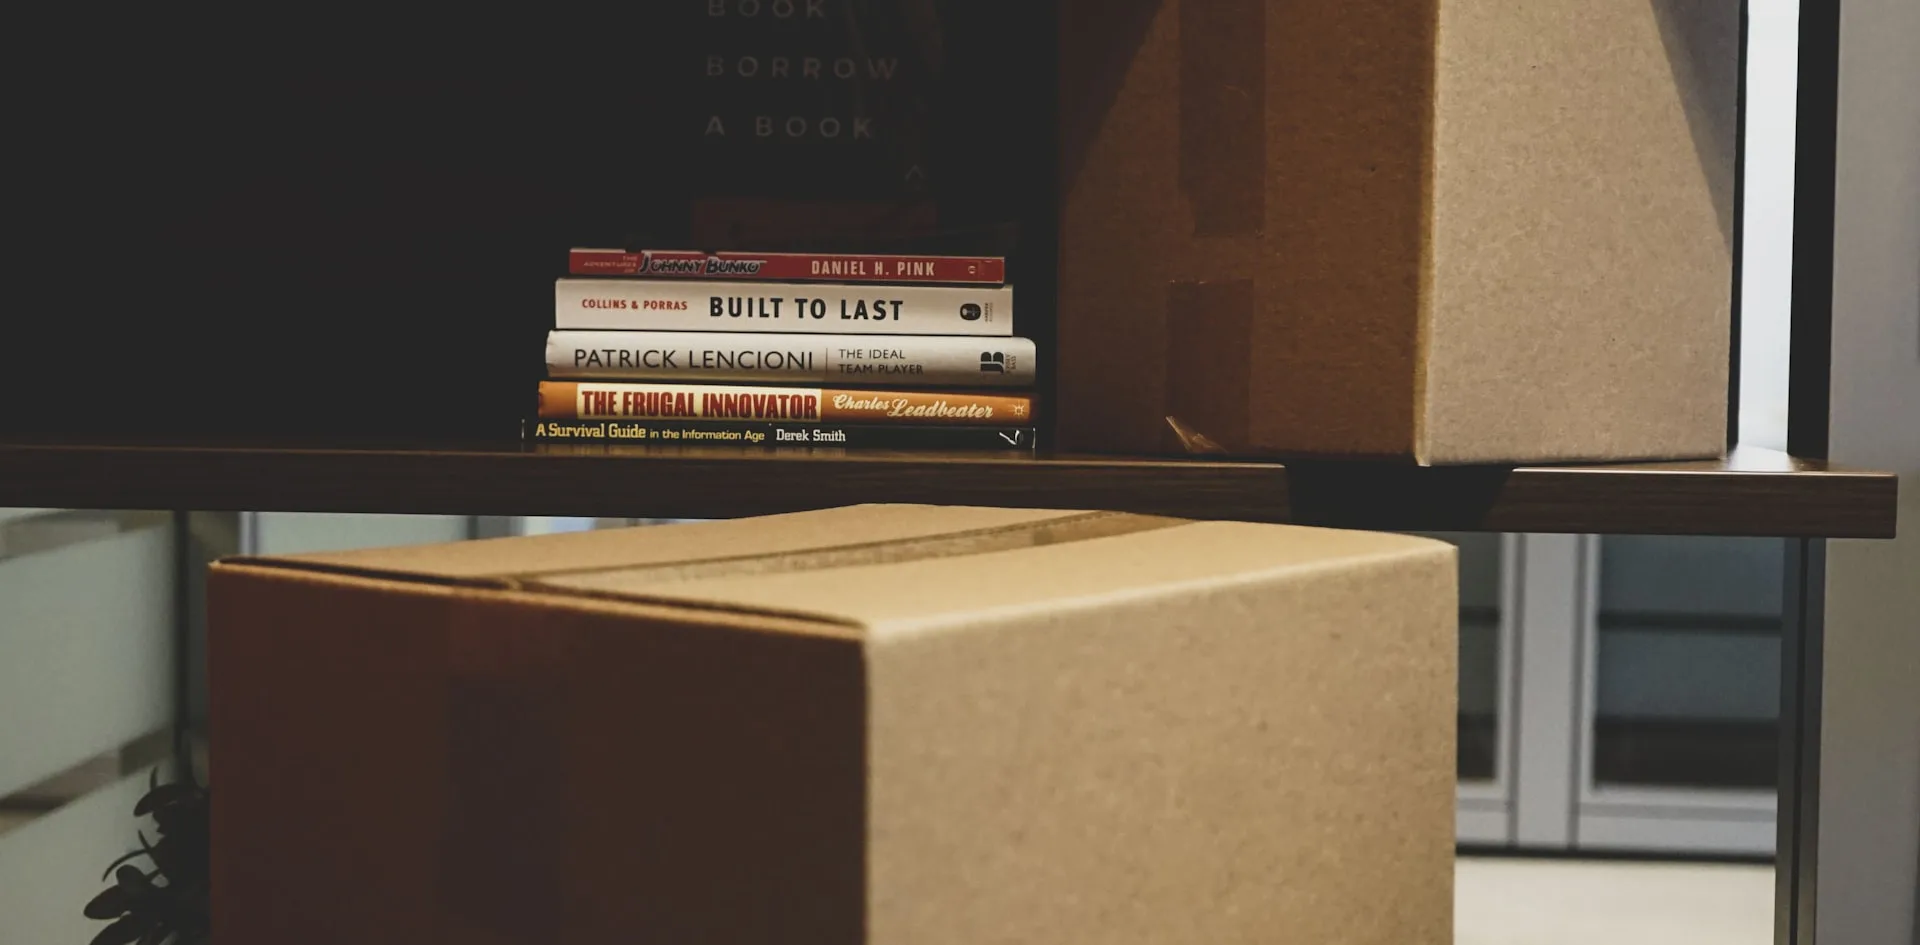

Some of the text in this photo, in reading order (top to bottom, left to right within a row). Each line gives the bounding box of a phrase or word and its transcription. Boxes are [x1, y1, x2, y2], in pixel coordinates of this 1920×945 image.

[708, 0, 825, 18] BOOK
[706, 55, 898, 80] BORROW
[704, 115, 873, 139] A BOOK
[639, 251, 763, 275] JOHNNY BUNKO
[811, 260, 936, 277] DANIEL H. PINK
[581, 298, 688, 311] COLLINS & PORRAS
[709, 296, 904, 322] BUILT TO LAST
[574, 349, 813, 371] PATRICK LENCIONI
[839, 349, 906, 360] THE IDEAL
[839, 363, 924, 375] TEAM PLAYER
[581, 390, 817, 420] THE FRUGAL INNOVATOR
[832, 393, 993, 419] Charles Leadbeater
[535, 422, 765, 442] A Survival Guide in the Information Age
[776, 428, 846, 442] Derek Smith
